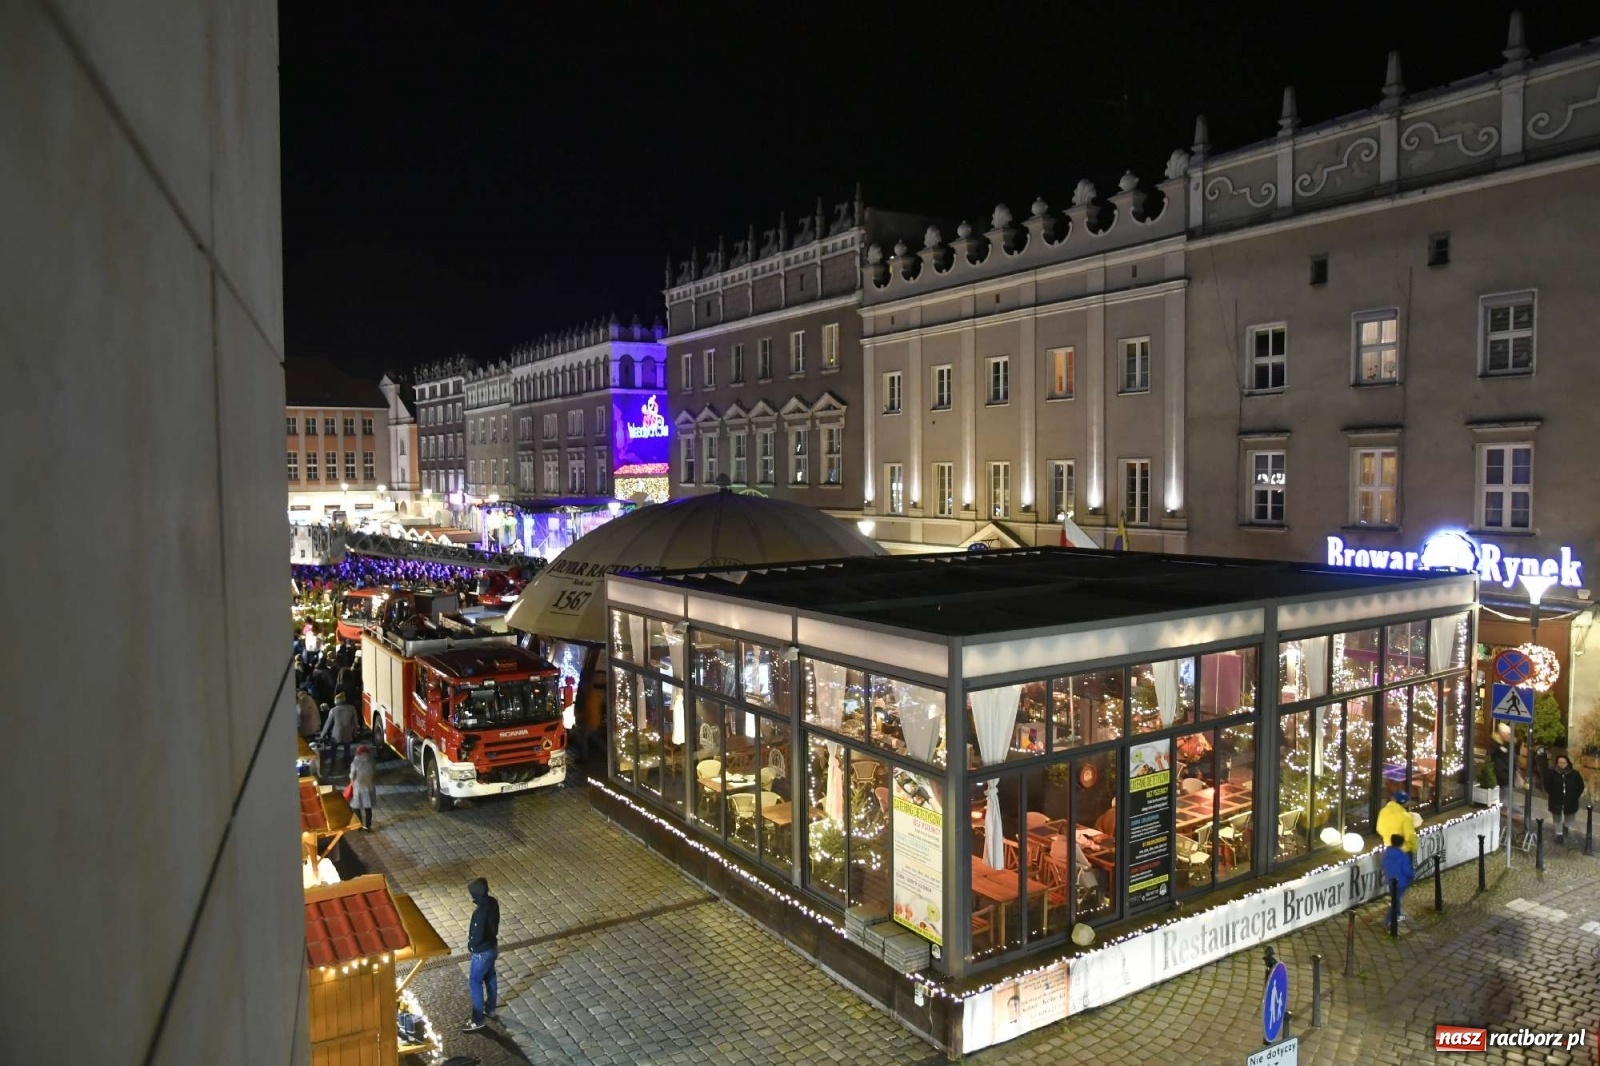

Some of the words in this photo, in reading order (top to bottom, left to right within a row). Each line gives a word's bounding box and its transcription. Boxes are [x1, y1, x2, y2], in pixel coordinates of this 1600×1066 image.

[1327, 536, 1419, 571] Browar
[1480, 543, 1582, 588] Rynek
[552, 590, 592, 612] 1567
[499, 729, 529, 738] SCANIA
[1162, 898, 1277, 971] Restauracja
[1283, 880, 1345, 926] Browar
[1349, 864, 1386, 901] Ryne
[1250, 1055, 1264, 1066] Nie
[1266, 1042, 1297, 1060] dotyczy
